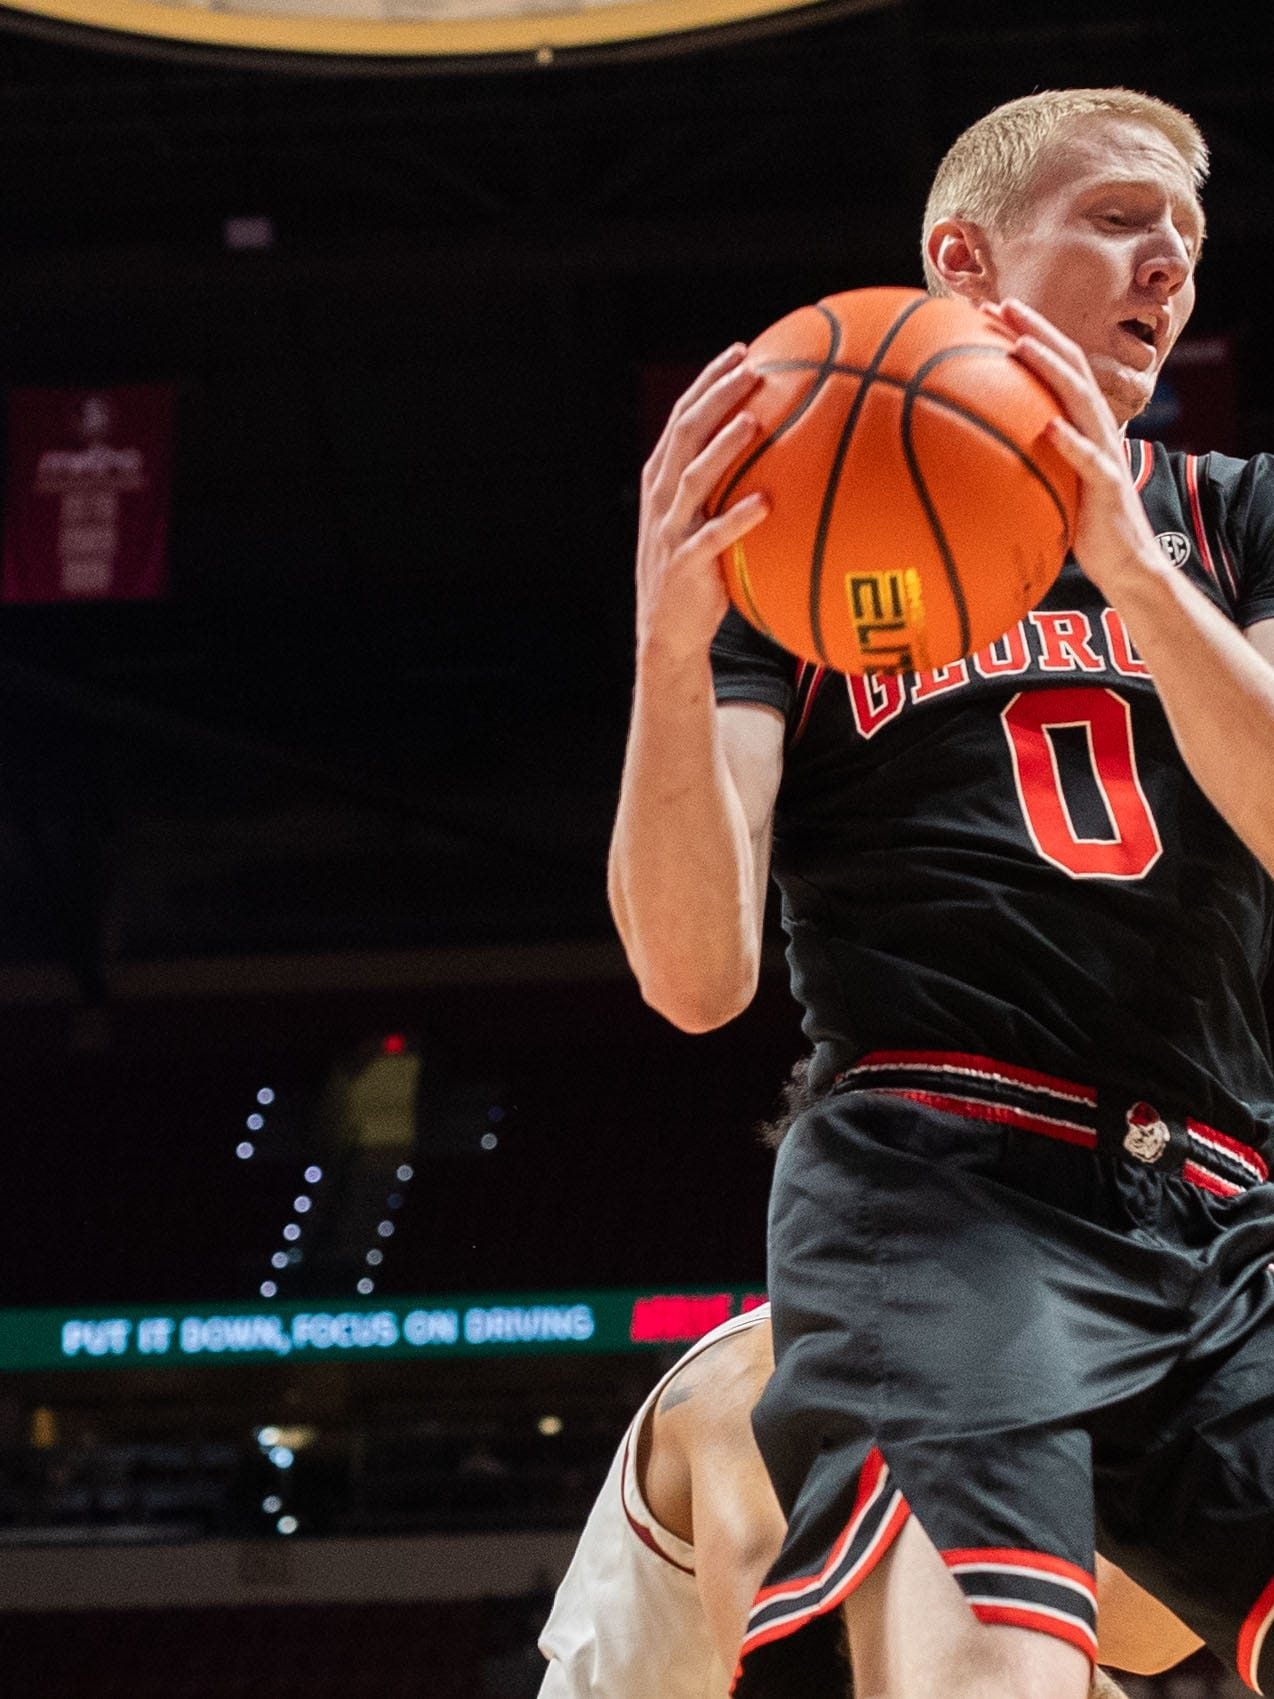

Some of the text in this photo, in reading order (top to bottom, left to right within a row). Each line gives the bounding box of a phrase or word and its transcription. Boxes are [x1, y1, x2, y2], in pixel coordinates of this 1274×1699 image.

[1001, 688, 1162, 880] 0
[62, 1318, 131, 1356] PUT
[138, 1317, 174, 1354] IT
